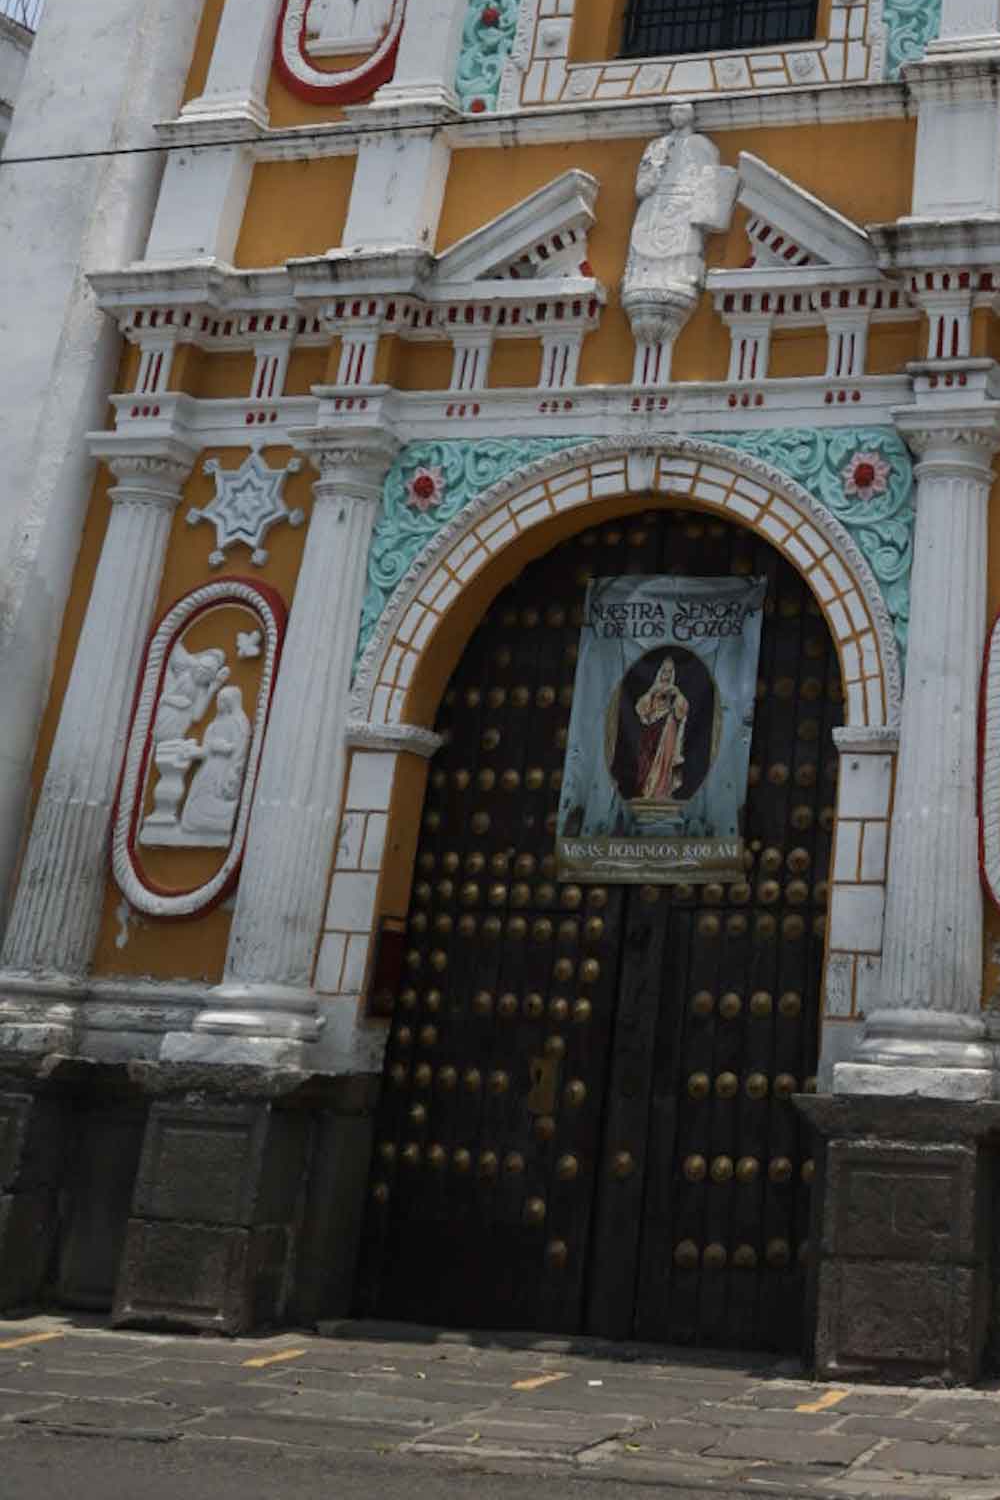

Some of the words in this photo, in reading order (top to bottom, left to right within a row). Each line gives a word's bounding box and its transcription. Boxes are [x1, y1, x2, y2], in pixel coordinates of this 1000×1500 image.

[591, 602, 664, 620] NUESTRA
[602, 621, 625, 638] DE
[632, 620, 665, 638] LOS
[672, 613, 744, 641] GOZOS
[608, 843, 677, 859] DOMINGOS
